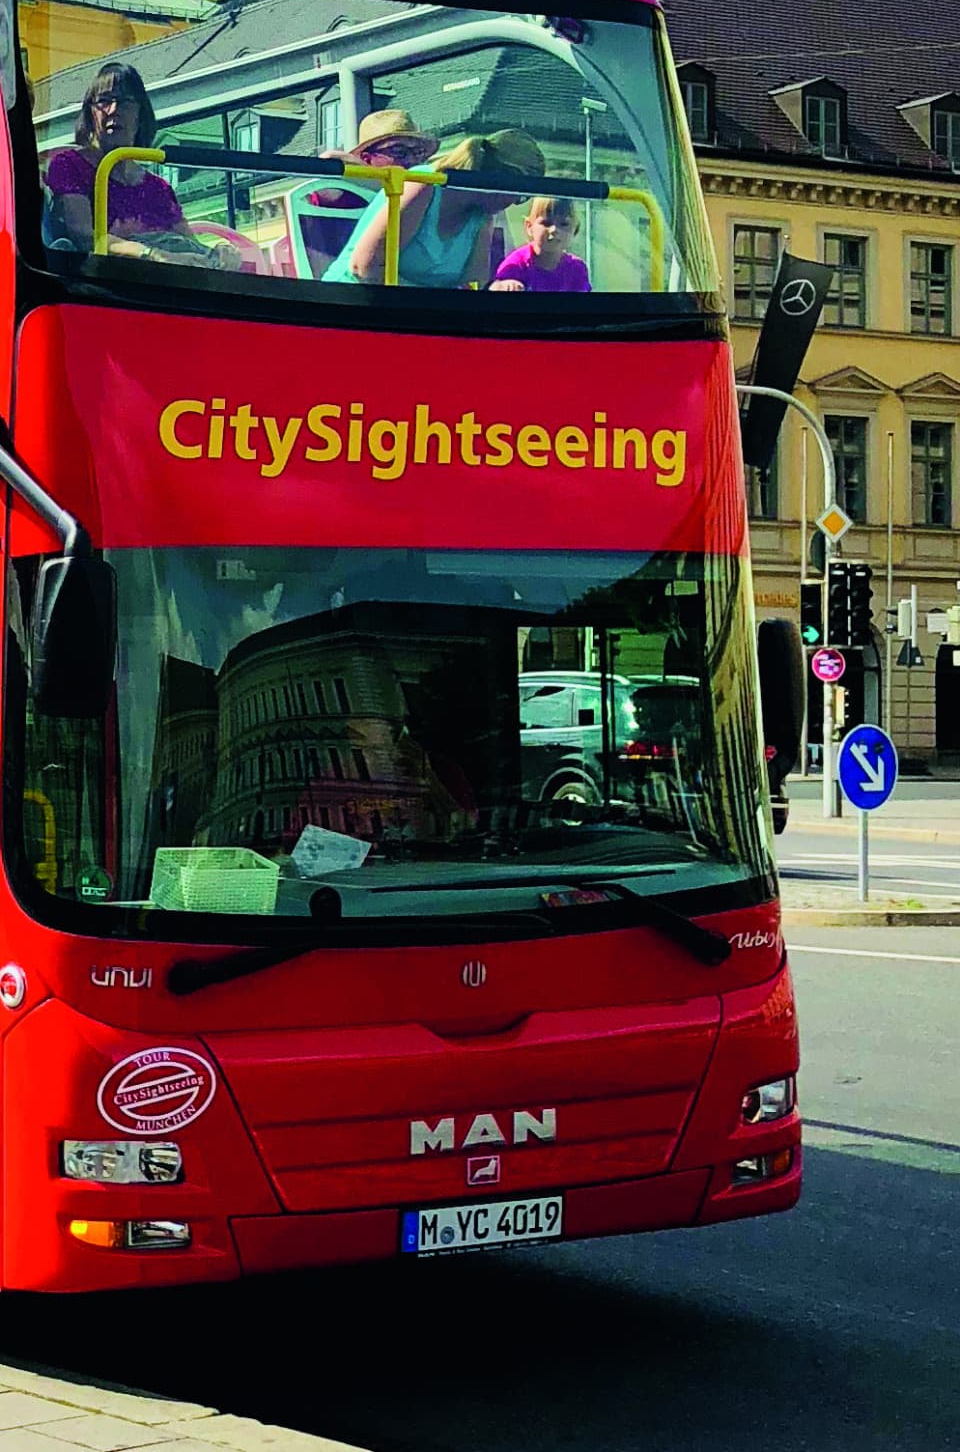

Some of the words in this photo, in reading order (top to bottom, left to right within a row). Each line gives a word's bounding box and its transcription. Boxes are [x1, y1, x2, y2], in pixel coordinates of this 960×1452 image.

[158, 398, 688, 487] CitySightseeing
[133, 1051, 171, 1068] TOUR
[113, 1075, 205, 1105] CitySightseeing
[410, 1108, 557, 1155] MAN
[421, 1214, 438, 1246] M
[456, 1209, 489, 1241] YC
[497, 1201, 560, 1237] 4019
